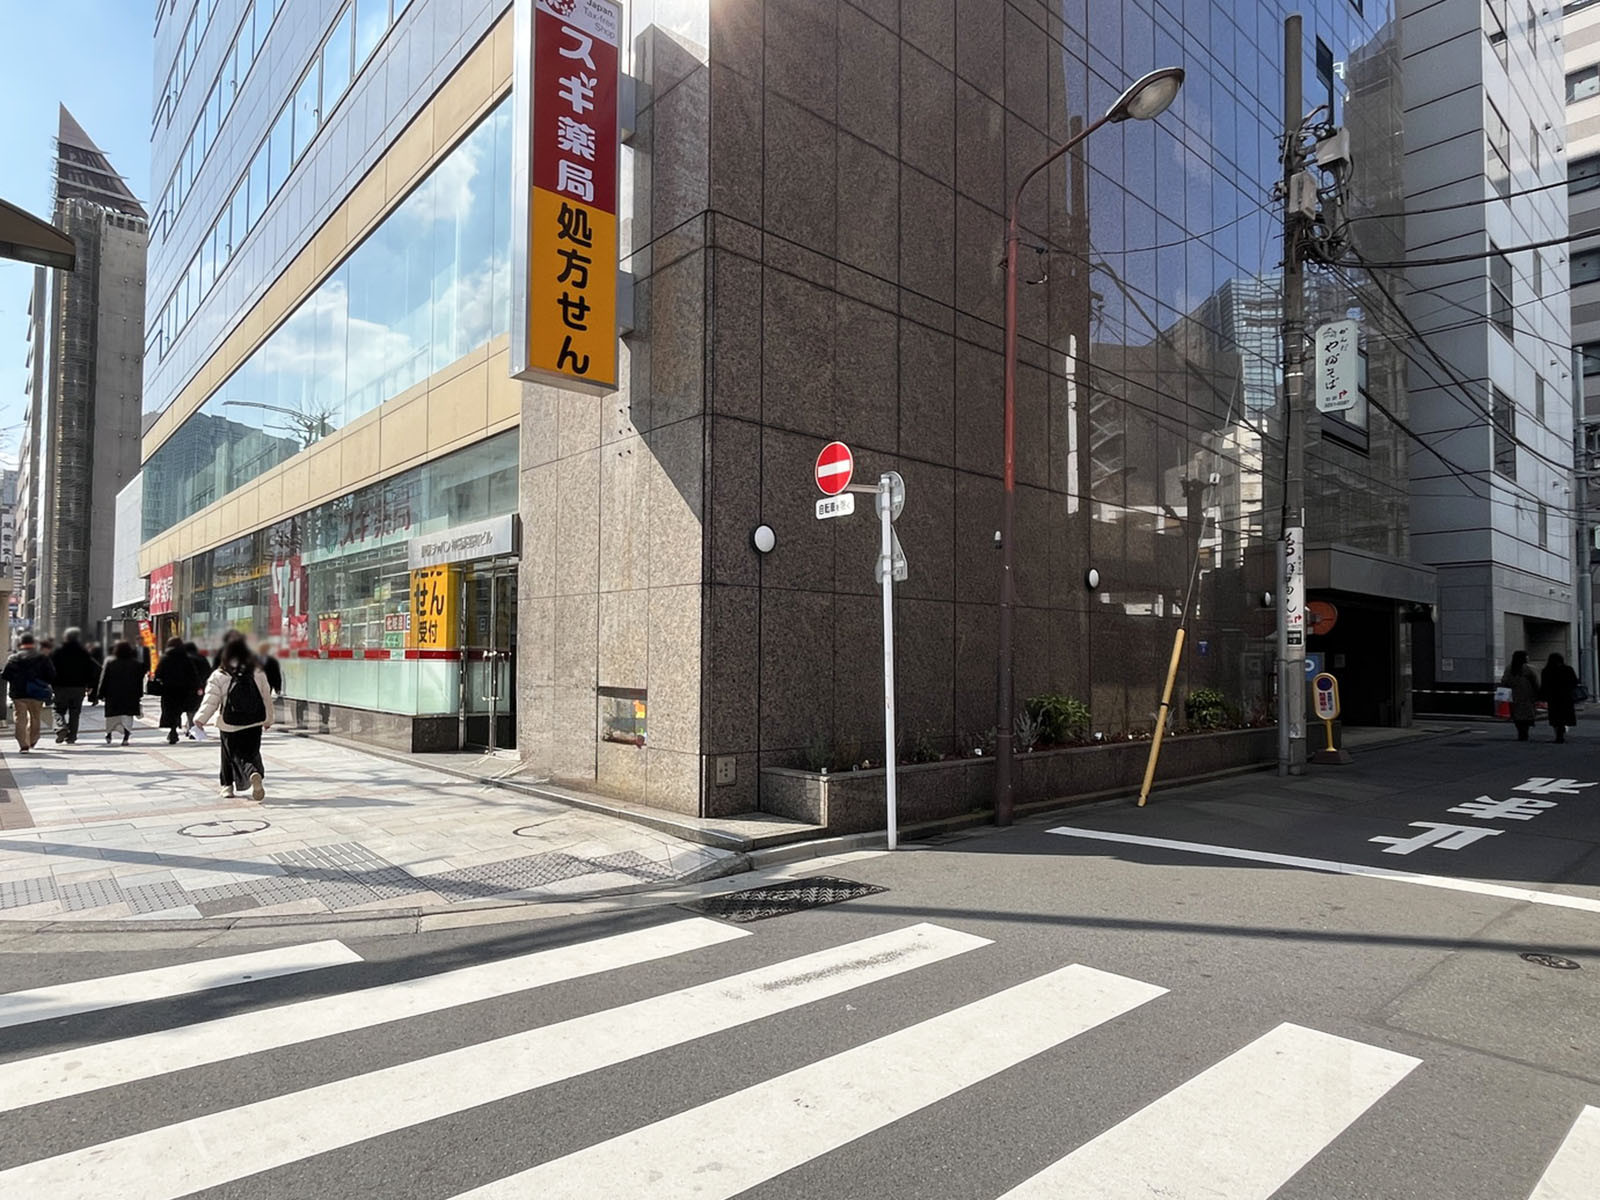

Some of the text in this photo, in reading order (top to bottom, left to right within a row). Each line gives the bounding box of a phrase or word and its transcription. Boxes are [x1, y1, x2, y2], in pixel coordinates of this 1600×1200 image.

[595, 22, 616, 39] Shop
[556, 26, 597, 202] スギ薬局
[557, 202, 592, 375] 処方せん
[150, 575, 173, 605] スギ薬局
[414, 580, 445, 616] せん
[418, 620, 438, 644] 受付
